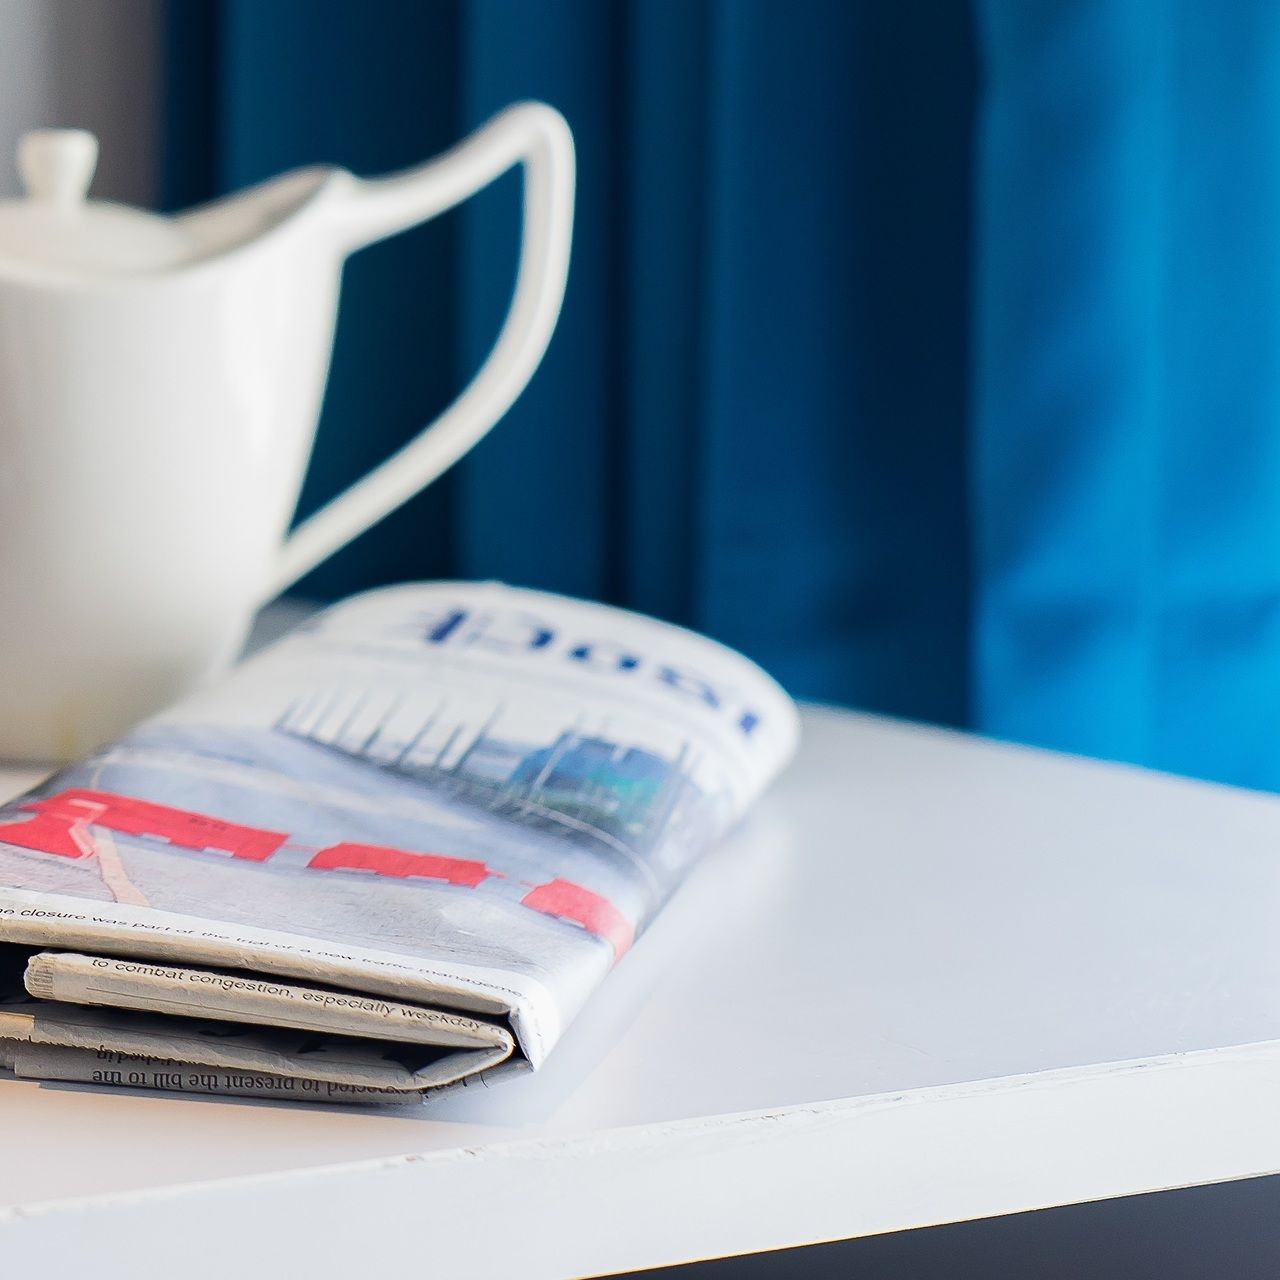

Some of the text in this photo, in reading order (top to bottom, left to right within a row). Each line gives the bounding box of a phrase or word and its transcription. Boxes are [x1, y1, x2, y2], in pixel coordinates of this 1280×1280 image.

[20, 907, 88, 920] closure
[91, 916, 128, 926] was
[132, 921, 172, 932] part
[176, 926, 197, 935] of
[201, 931, 231, 940] the
[91, 958, 109, 968] to
[115, 962, 185, 981] combat
[189, 973, 295, 999] congestion,
[302, 992, 396, 1018] especially
[400, 1008, 481, 1032] weekday
[92, 1069, 123, 1084] the
[128, 1070, 148, 1085] to
[153, 1071, 183, 1089] bill
[189, 1073, 220, 1090] the
[224, 1074, 296, 1092] present
[301, 1078, 320, 1092] to
